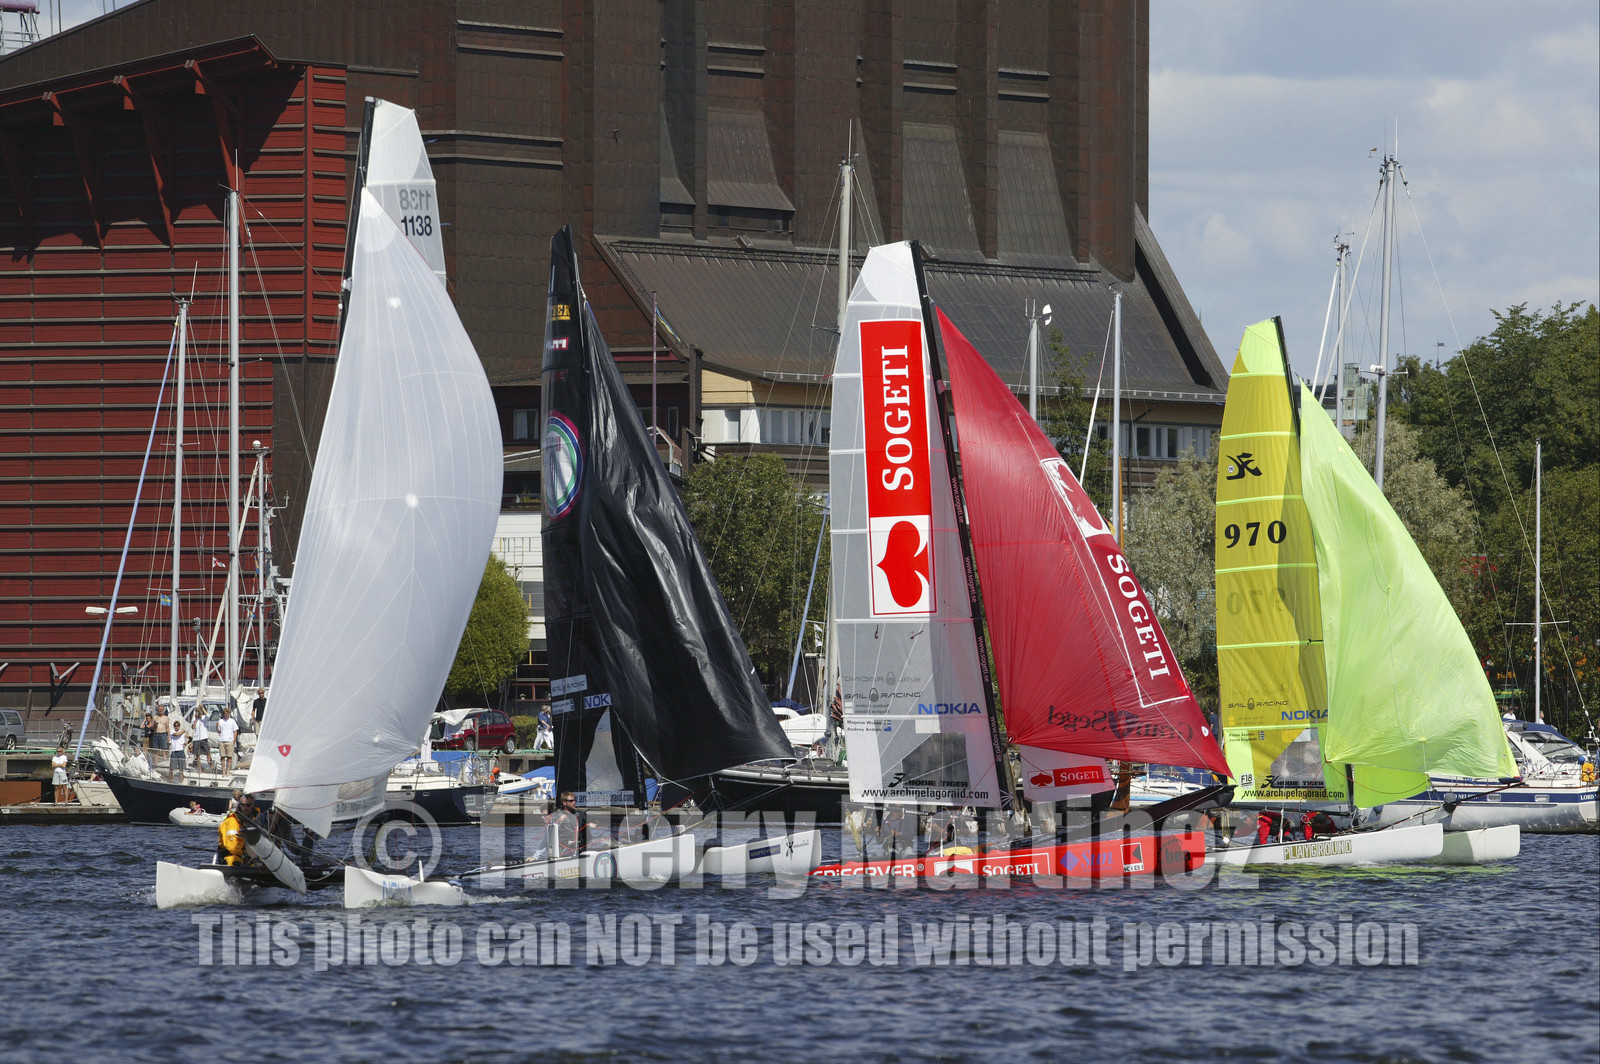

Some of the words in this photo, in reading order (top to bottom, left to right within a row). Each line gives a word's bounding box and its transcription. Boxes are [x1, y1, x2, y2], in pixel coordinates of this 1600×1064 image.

[401, 215, 432, 236] 1138
[881, 344, 914, 491] SOGETI
[1224, 520, 1287, 549] 970
[1107, 554, 1171, 680] SOGETI
[880, 691, 922, 699] RACING
[918, 703, 981, 714] NOKIA
[1281, 709, 1328, 721] NOKIA
[1060, 771, 1100, 782] SOGETI
[1240, 774, 1253, 783] F18
[861, 787, 989, 800] www.archipelagoraid.com
[1241, 788, 1345, 800] www.archipelagoraid.com
[1283, 840, 1352, 860] PLAYGROUND
[1080, 850, 1113, 868] Sun
[982, 862, 1040, 877] SOGETI
